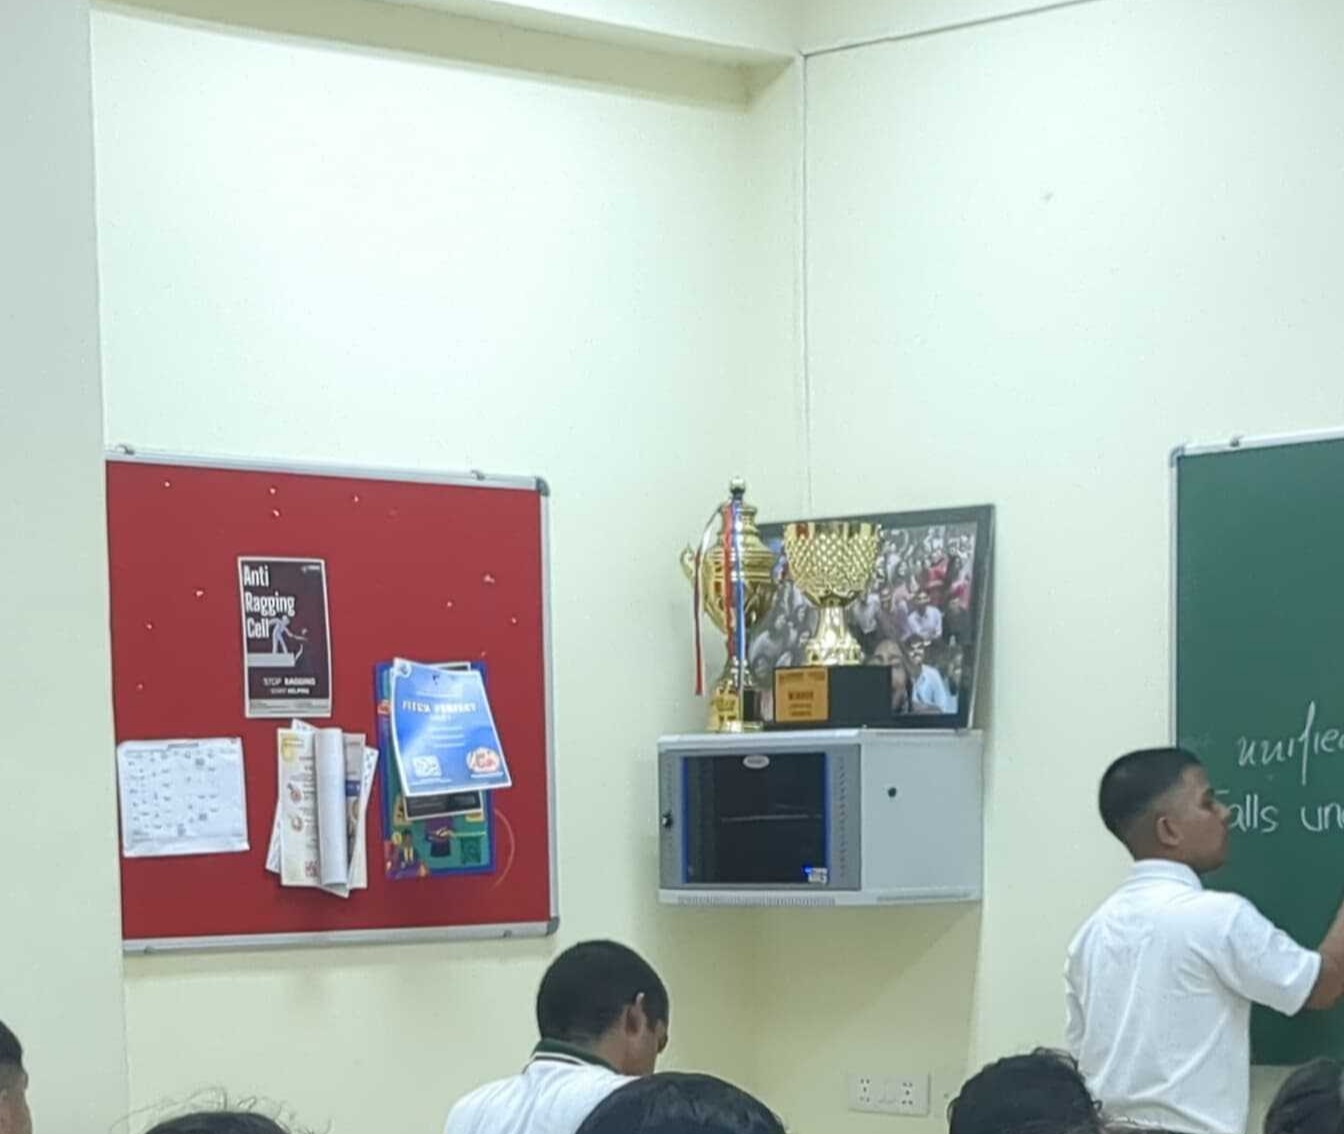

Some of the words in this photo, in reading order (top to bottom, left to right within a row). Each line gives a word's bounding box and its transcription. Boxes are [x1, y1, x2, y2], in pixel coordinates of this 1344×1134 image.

[243, 564, 269, 587] Anti
[244, 591, 296, 617] Ragging
[246, 617, 270, 639] Cell
